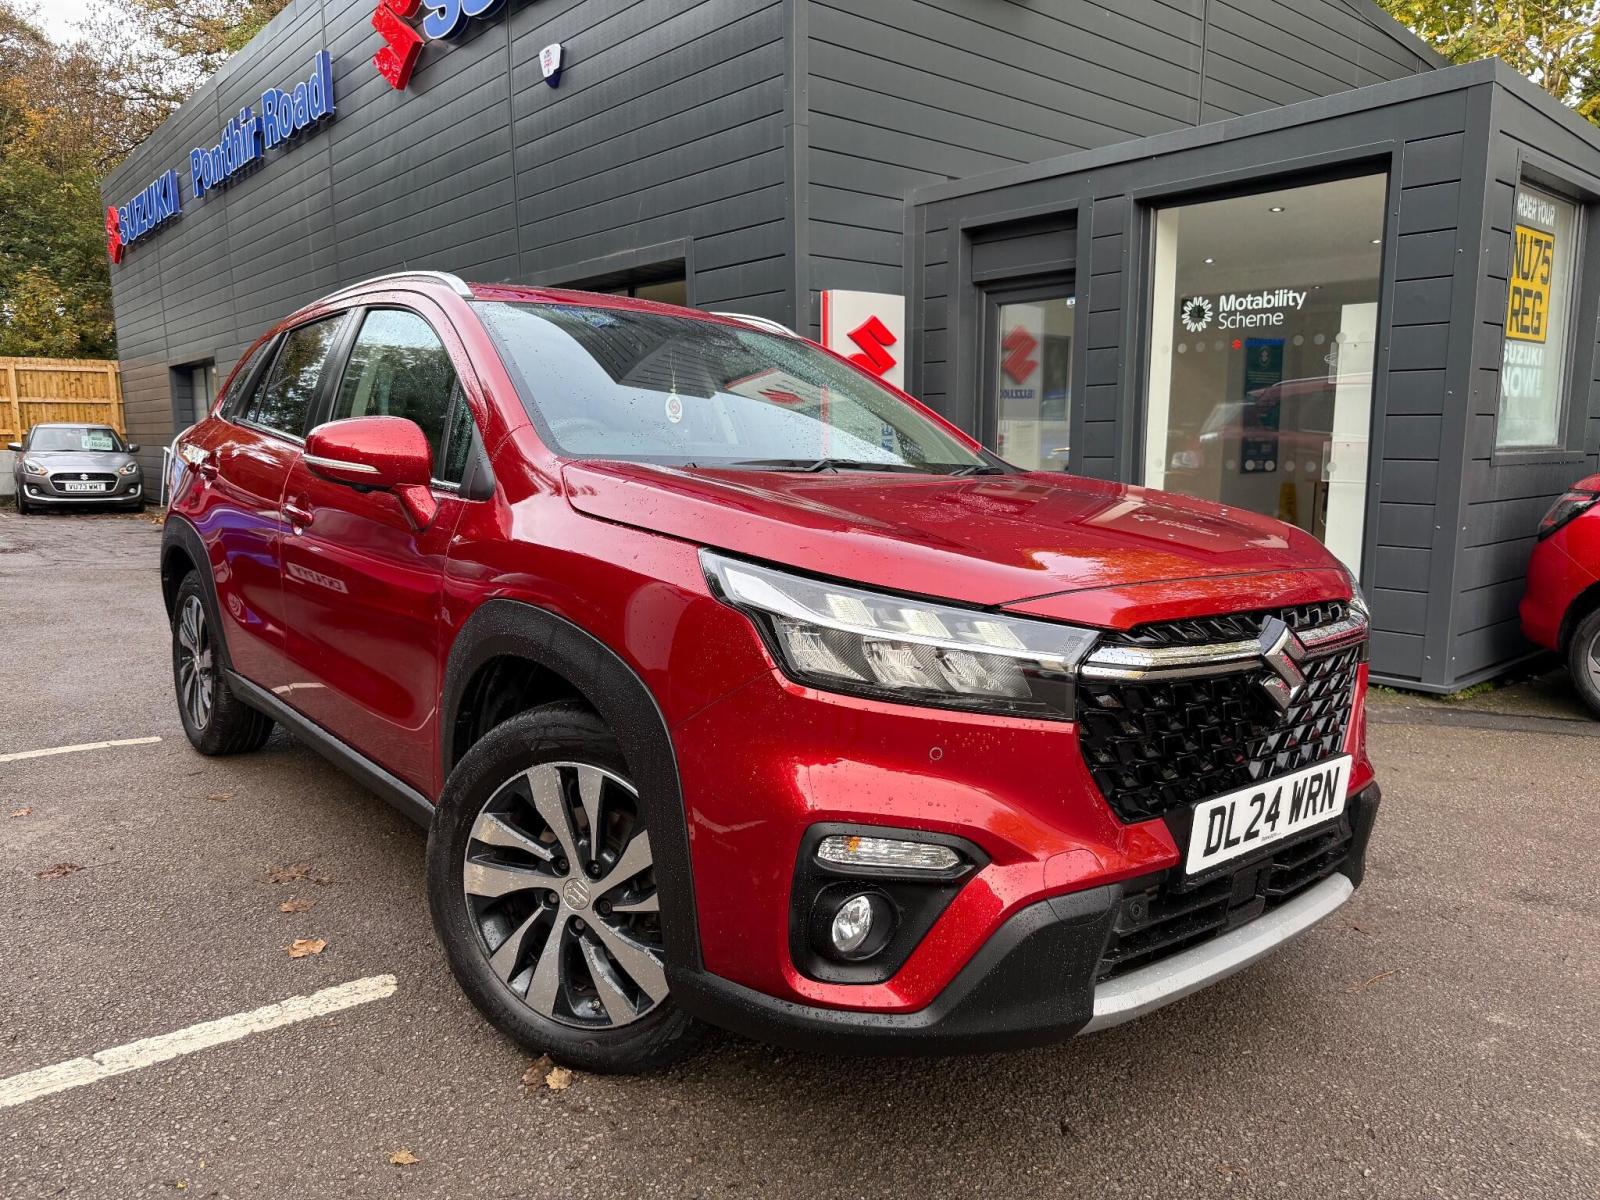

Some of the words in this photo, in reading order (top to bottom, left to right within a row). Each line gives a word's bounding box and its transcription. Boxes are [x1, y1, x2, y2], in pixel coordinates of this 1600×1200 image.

[118, 169, 179, 245] SUZUKI
[190, 107, 261, 198] Ponthir
[261, 50, 332, 149] Road
[1538, 200, 1555, 227] YOUR
[1219, 290, 1307, 313] Motability
[1509, 286, 1542, 336] REG
[1218, 312, 1284, 330] Scheme
[1203, 786, 1283, 858] DL24
[1288, 766, 1340, 825] WRN
